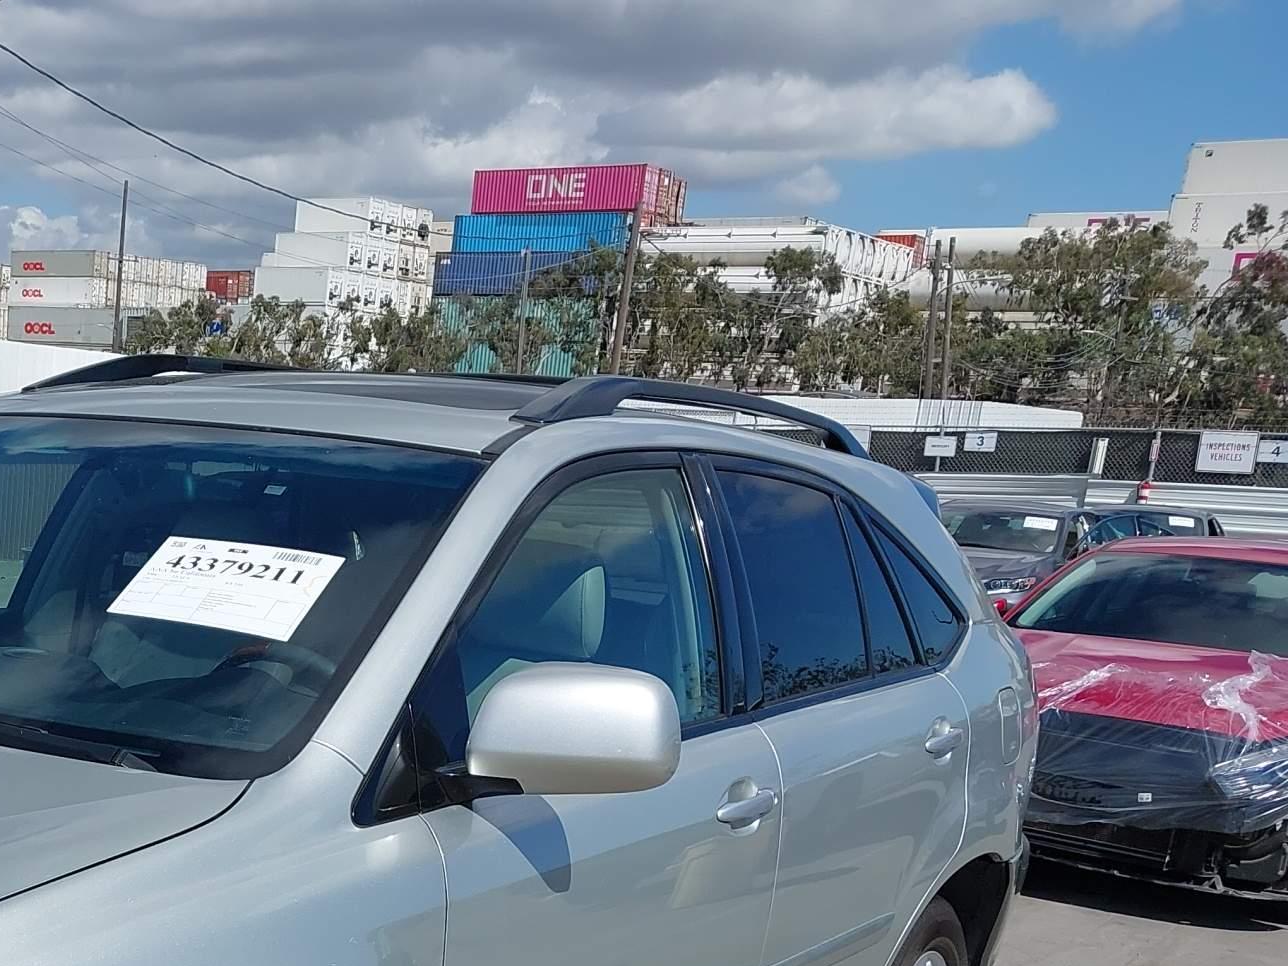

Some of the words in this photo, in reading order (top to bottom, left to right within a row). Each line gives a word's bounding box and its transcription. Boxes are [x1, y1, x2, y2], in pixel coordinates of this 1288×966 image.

[526, 172, 587, 198] ONE
[23, 262, 45, 271] OOCL
[22, 288, 44, 298] OOCL
[24, 322, 55, 335] OOCL
[976, 436, 985, 447] 3
[1205, 442, 1252, 452] INSPECTIONS
[1209, 452, 1243, 462] VEHICLES
[1271, 446, 1281, 457] 4
[165, 553, 305, 585] 43379211
